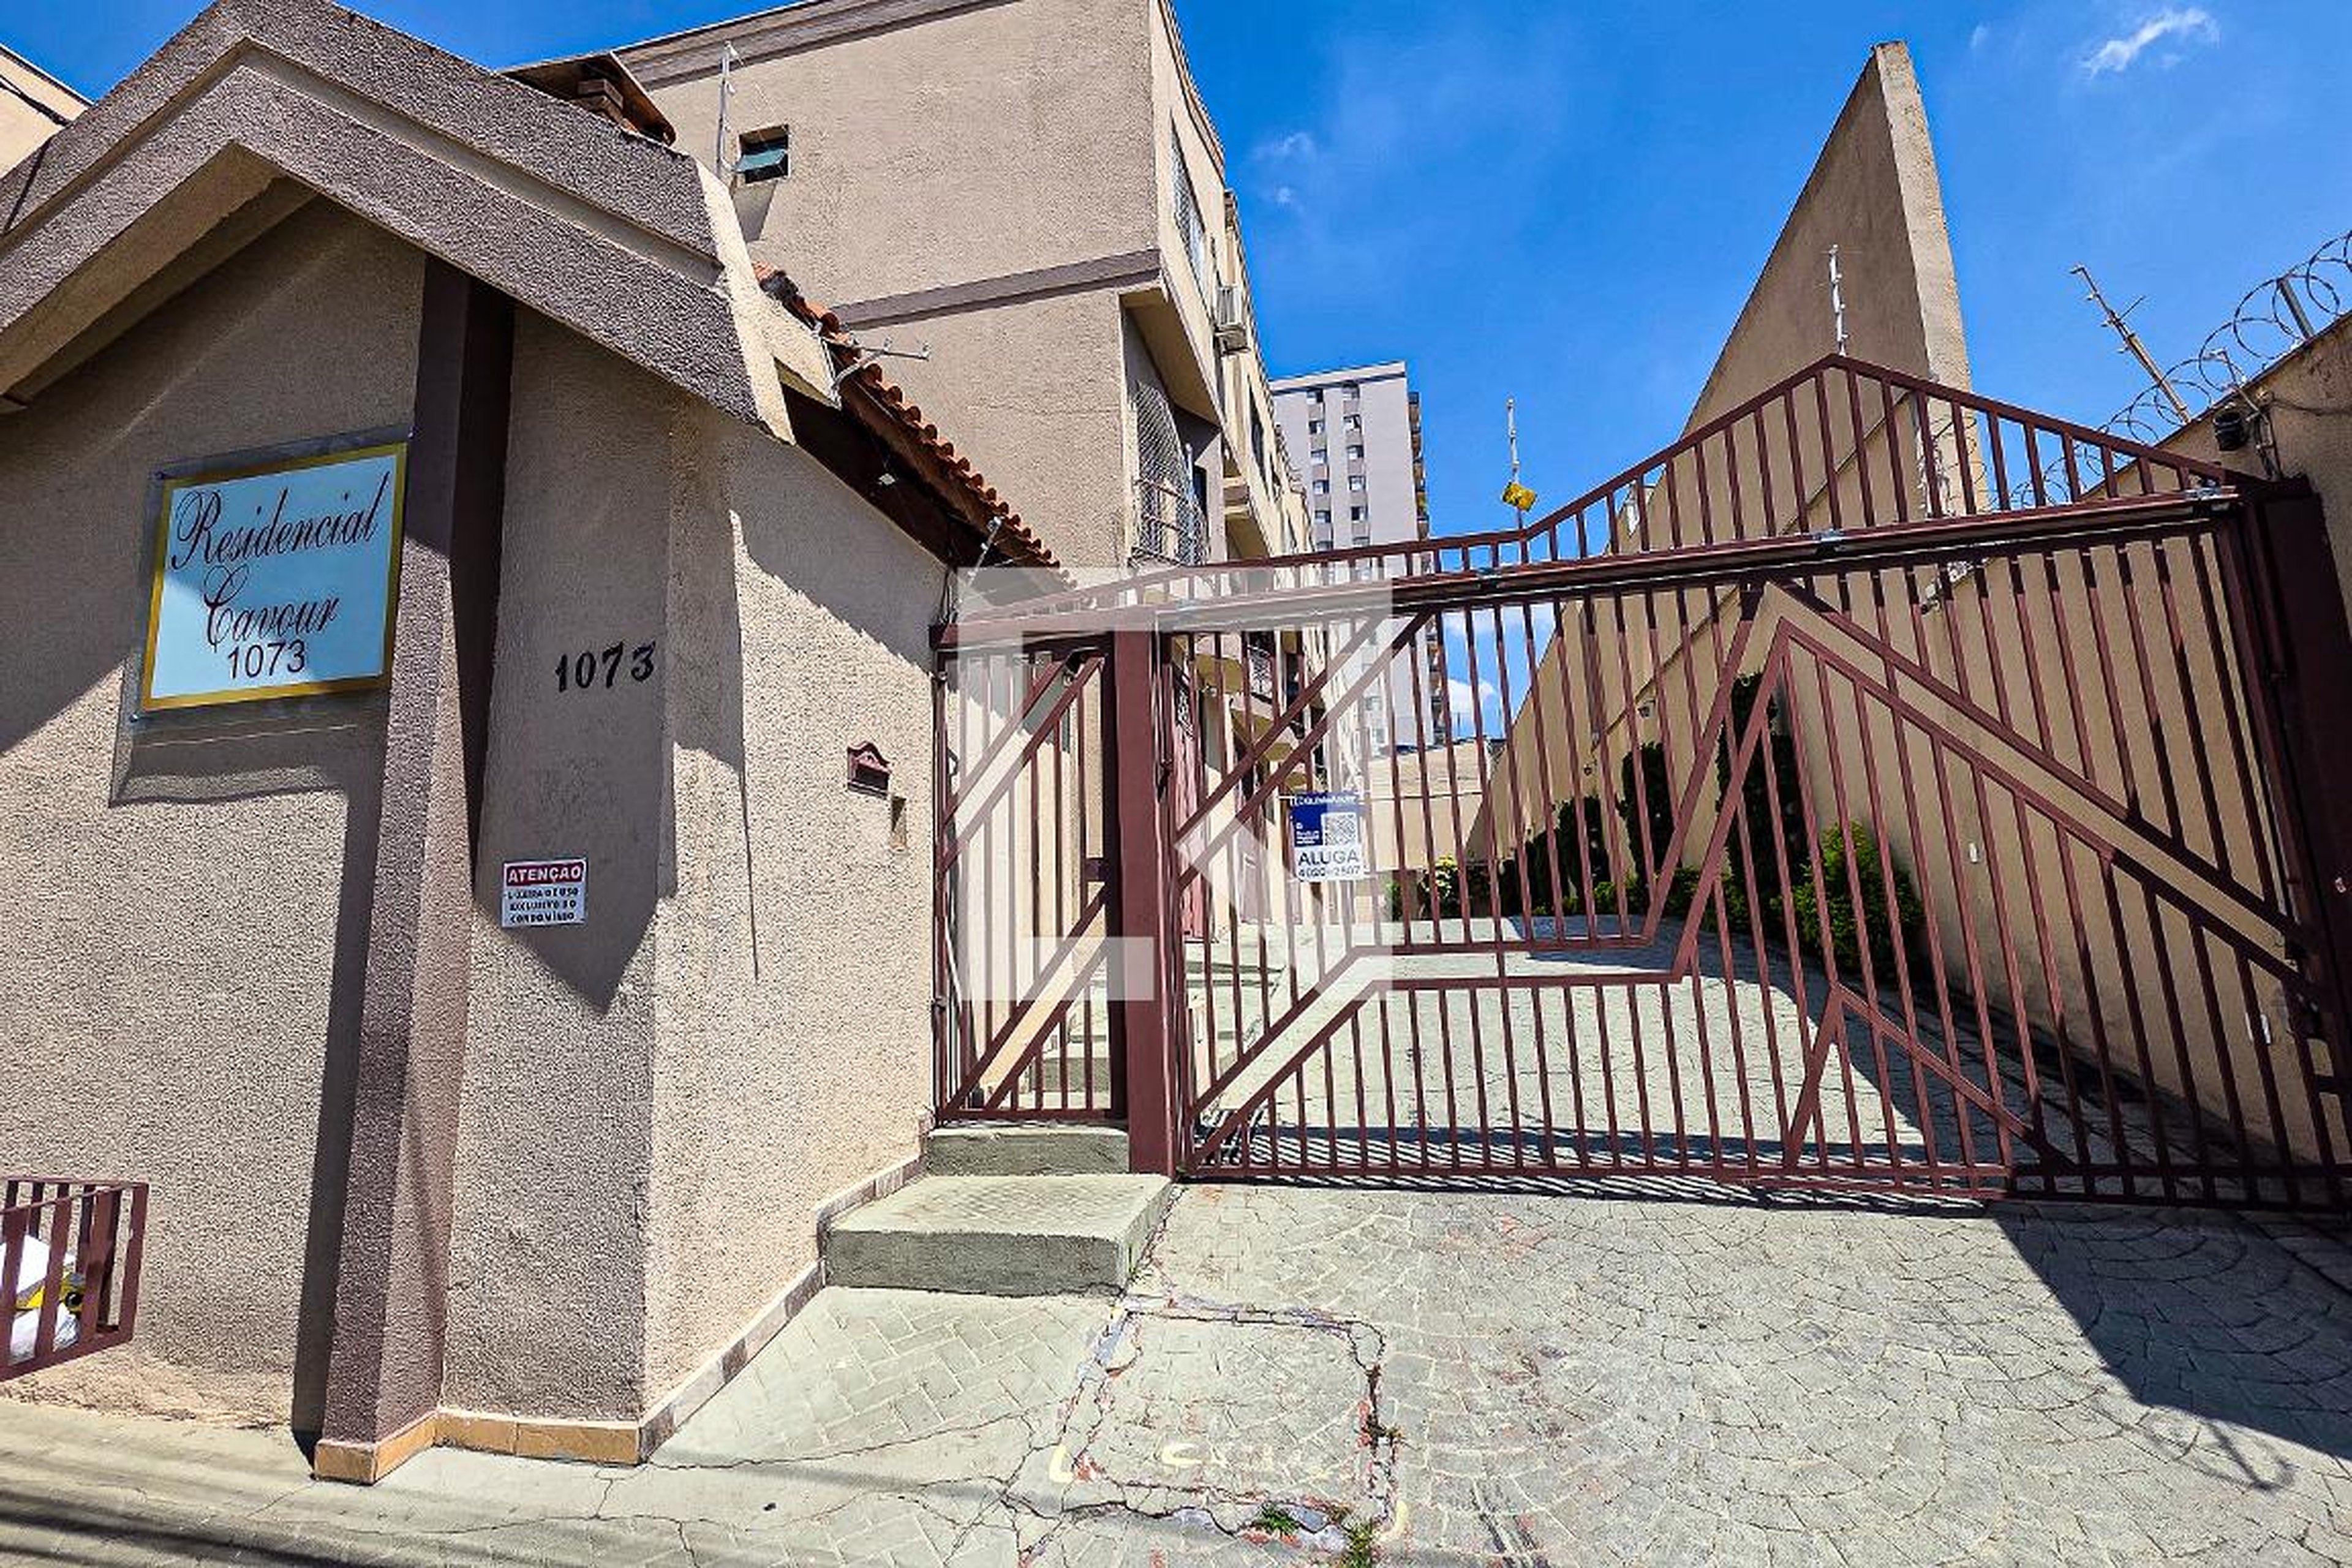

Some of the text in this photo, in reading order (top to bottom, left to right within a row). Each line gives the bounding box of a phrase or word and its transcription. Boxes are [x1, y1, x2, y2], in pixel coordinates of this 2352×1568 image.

[172, 471, 390, 570] Residencial
[203, 565, 339, 652] Cavour
[227, 639, 306, 679] 1073
[554, 640, 656, 693] 1073
[1298, 849, 1359, 865] ALUGA
[559, 888, 579, 897] USO
